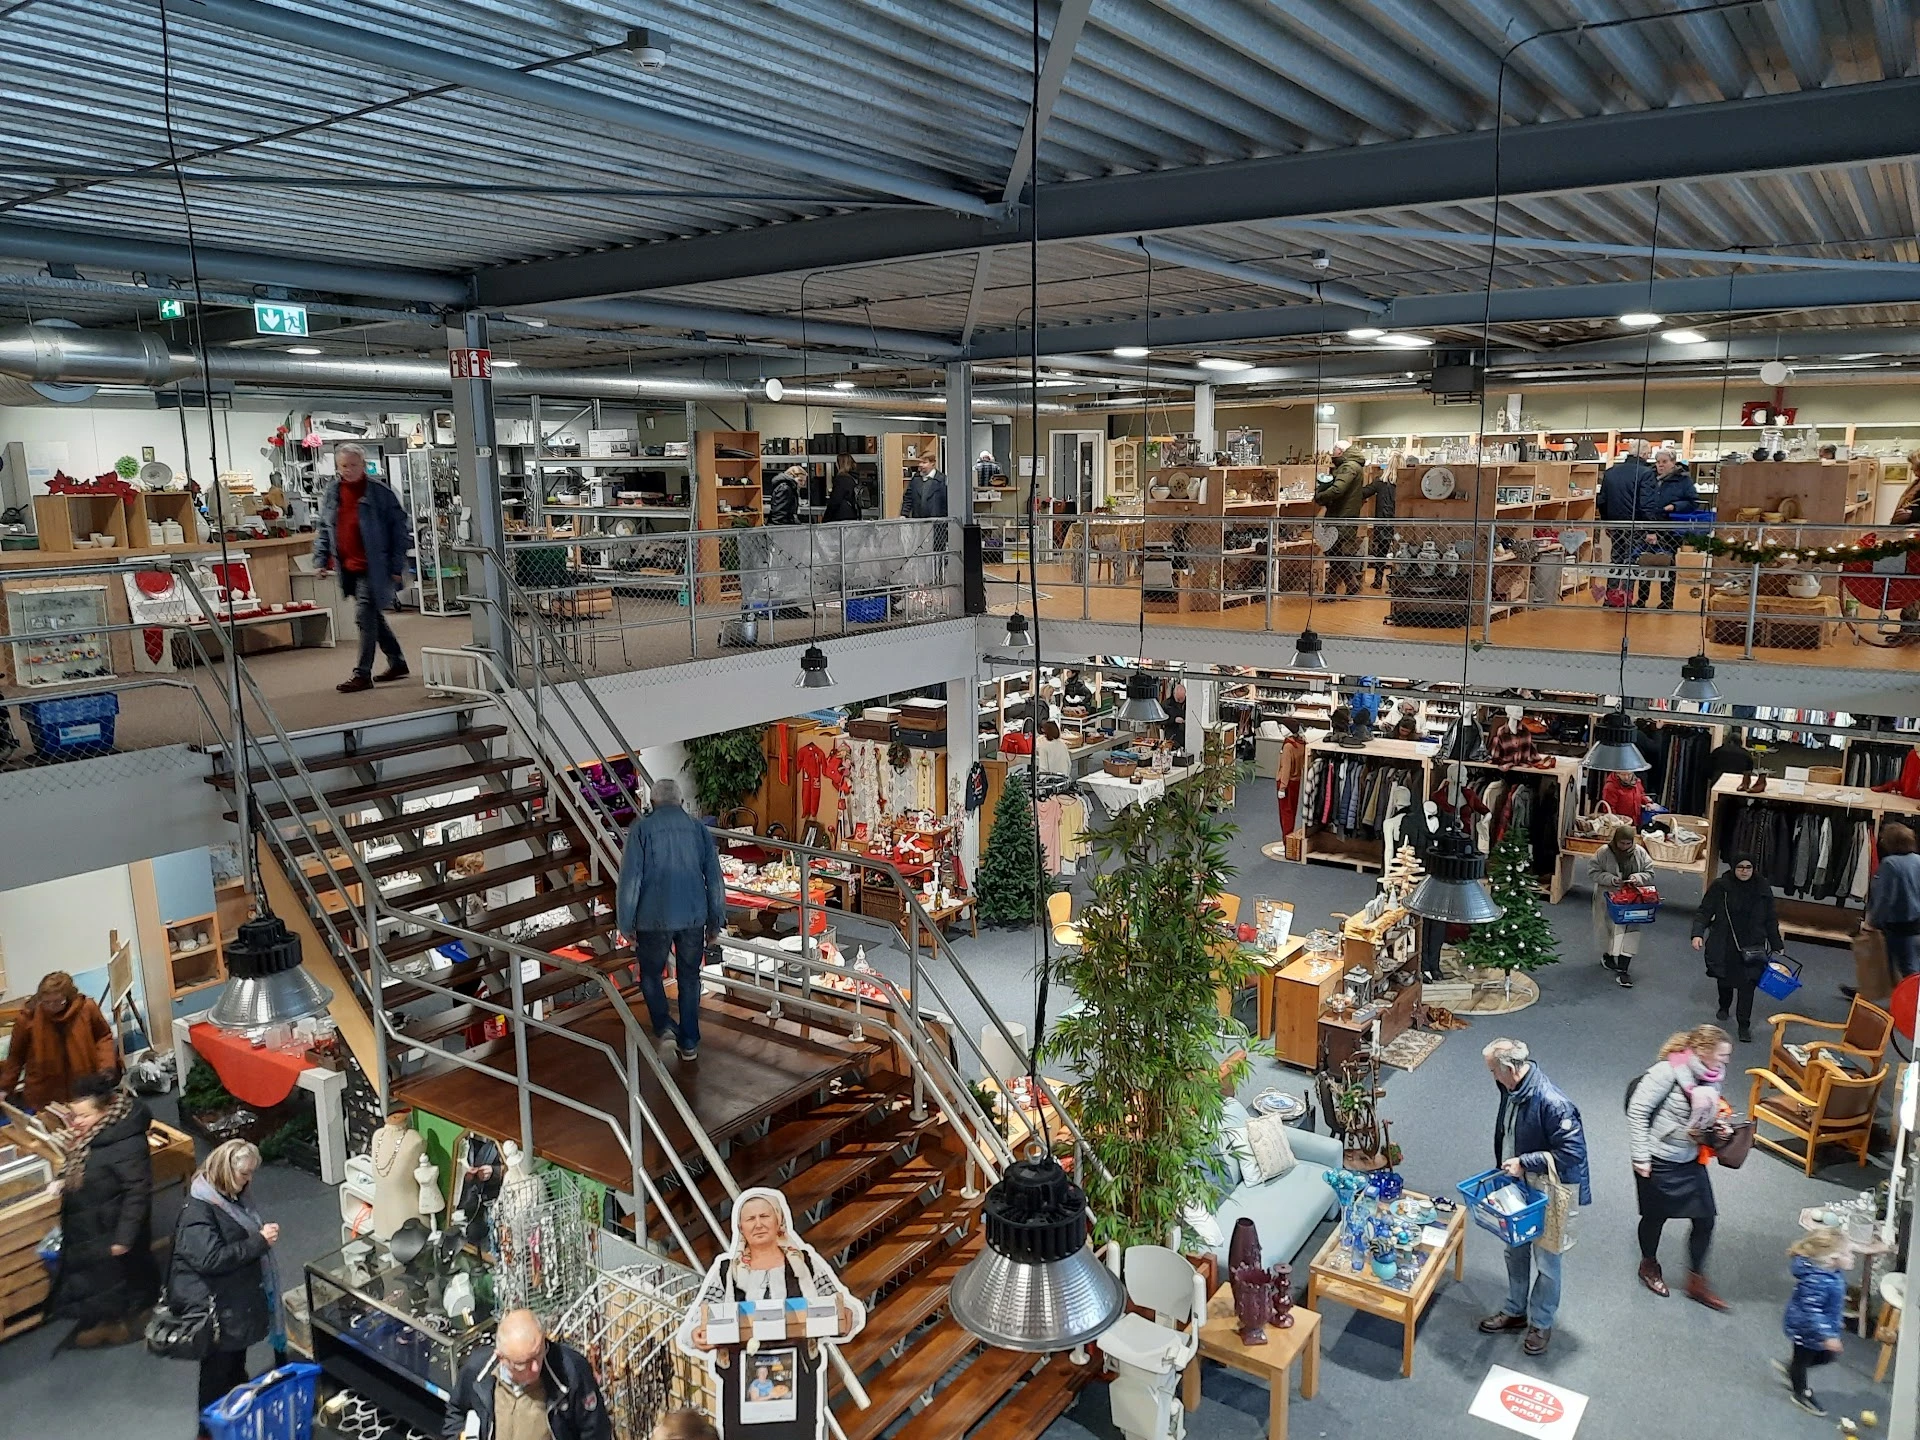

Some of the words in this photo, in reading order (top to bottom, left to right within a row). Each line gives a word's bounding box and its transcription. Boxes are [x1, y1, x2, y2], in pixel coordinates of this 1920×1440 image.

[1518, 1385, 1534, 1395] m
[1506, 1395, 1555, 1416] afstand
[1511, 1405, 1542, 1422] houd
